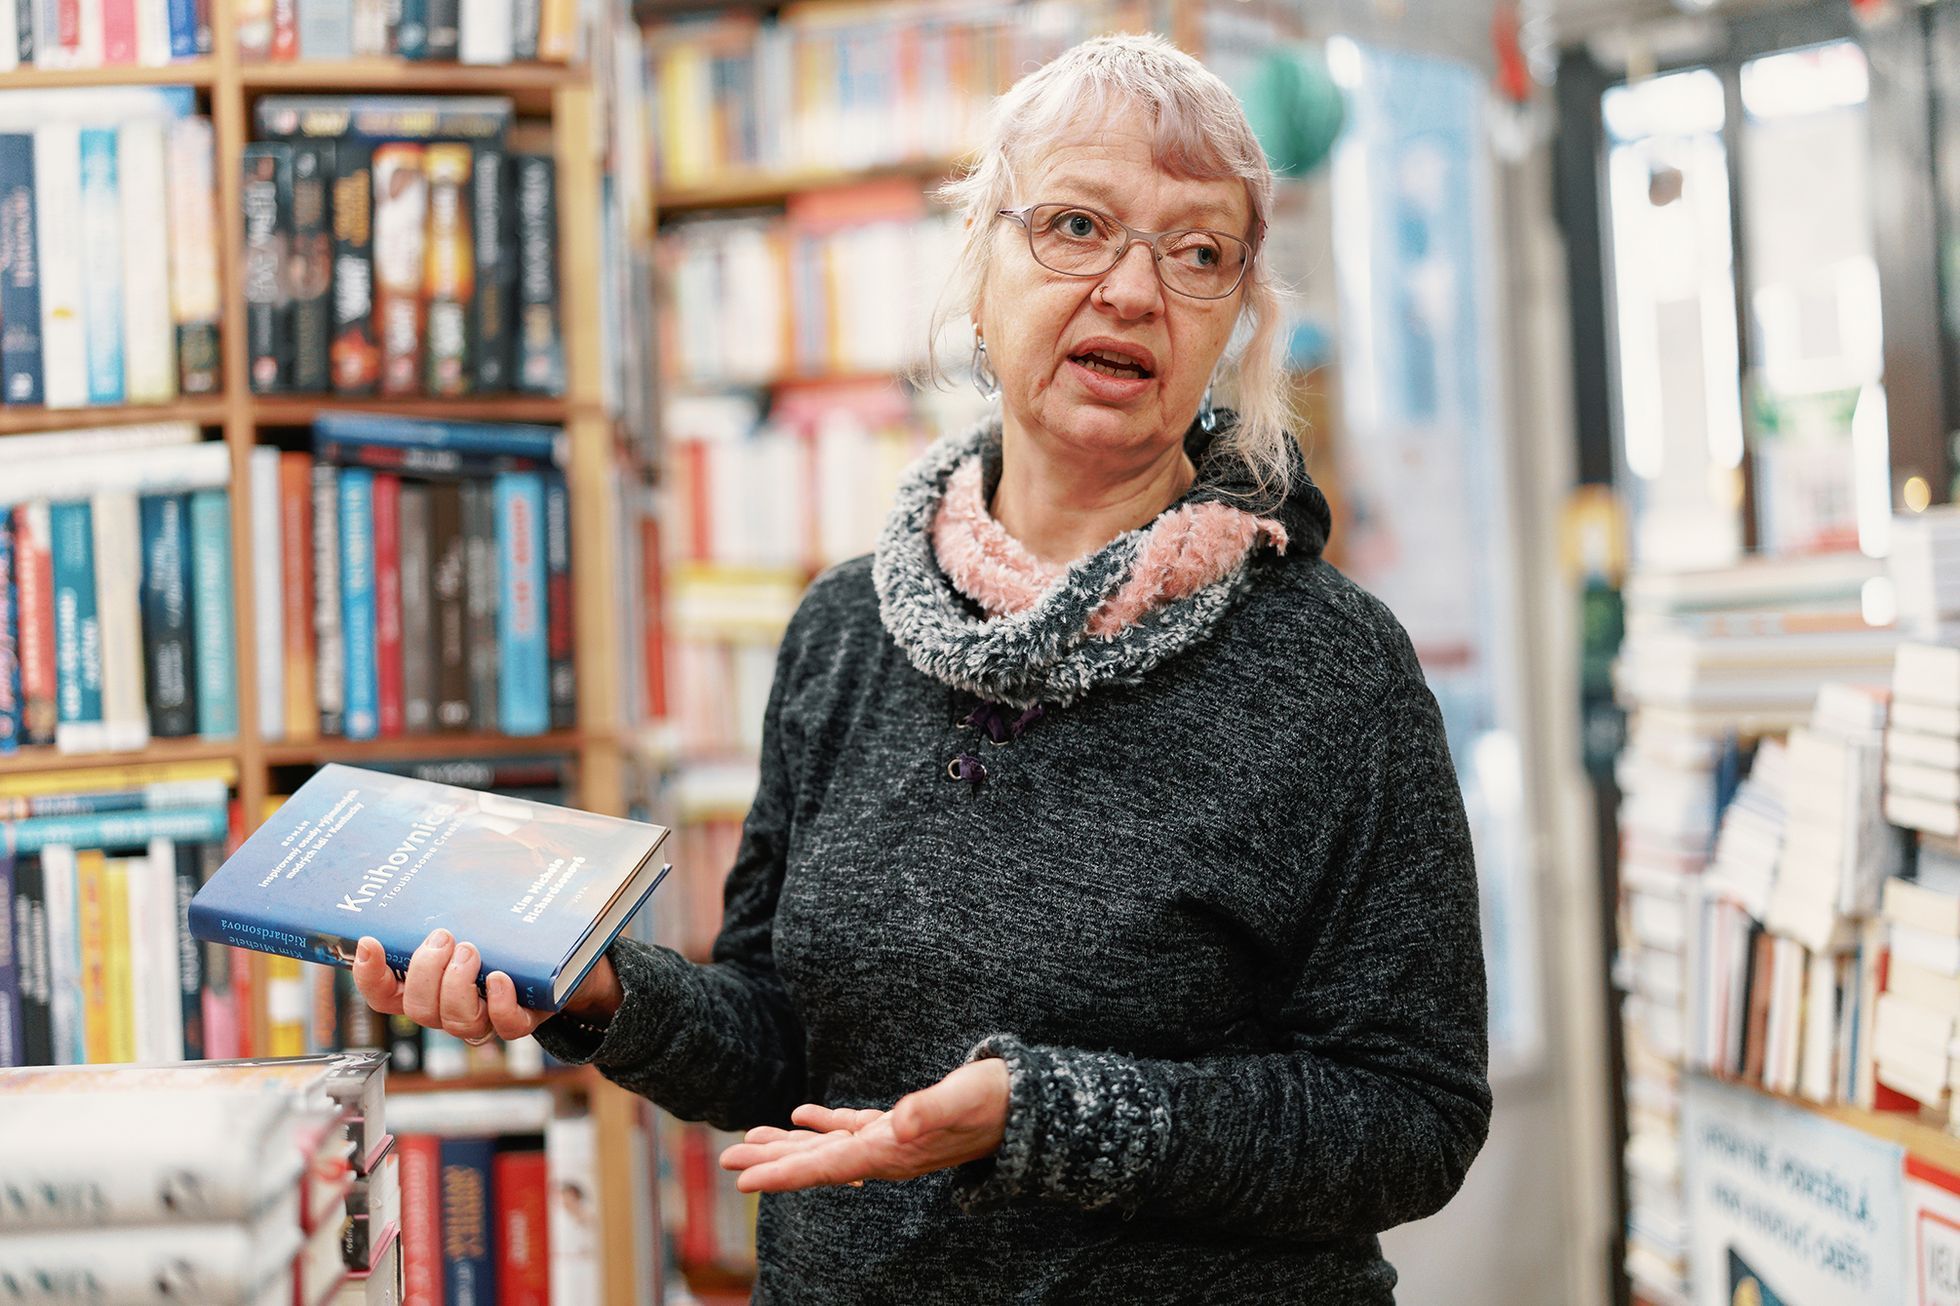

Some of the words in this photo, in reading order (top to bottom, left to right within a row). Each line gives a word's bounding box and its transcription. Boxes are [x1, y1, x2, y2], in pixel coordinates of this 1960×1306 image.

[281, 819, 310, 846] ROMÁN
[298, 826, 322, 849] osudy
[286, 848, 318, 879] modrých
[335, 802, 456, 913] Knihovnice
[382, 846, 439, 900] Troublesome
[510, 894, 534, 914] Kim
[527, 857, 565, 895] Michele
[378, 900, 388, 909] z
[522, 856, 587, 924] Richardsonová
[220, 919, 307, 948] Richardsonová
[229, 936, 277, 953] Michele
[278, 947, 303, 959] Kim
